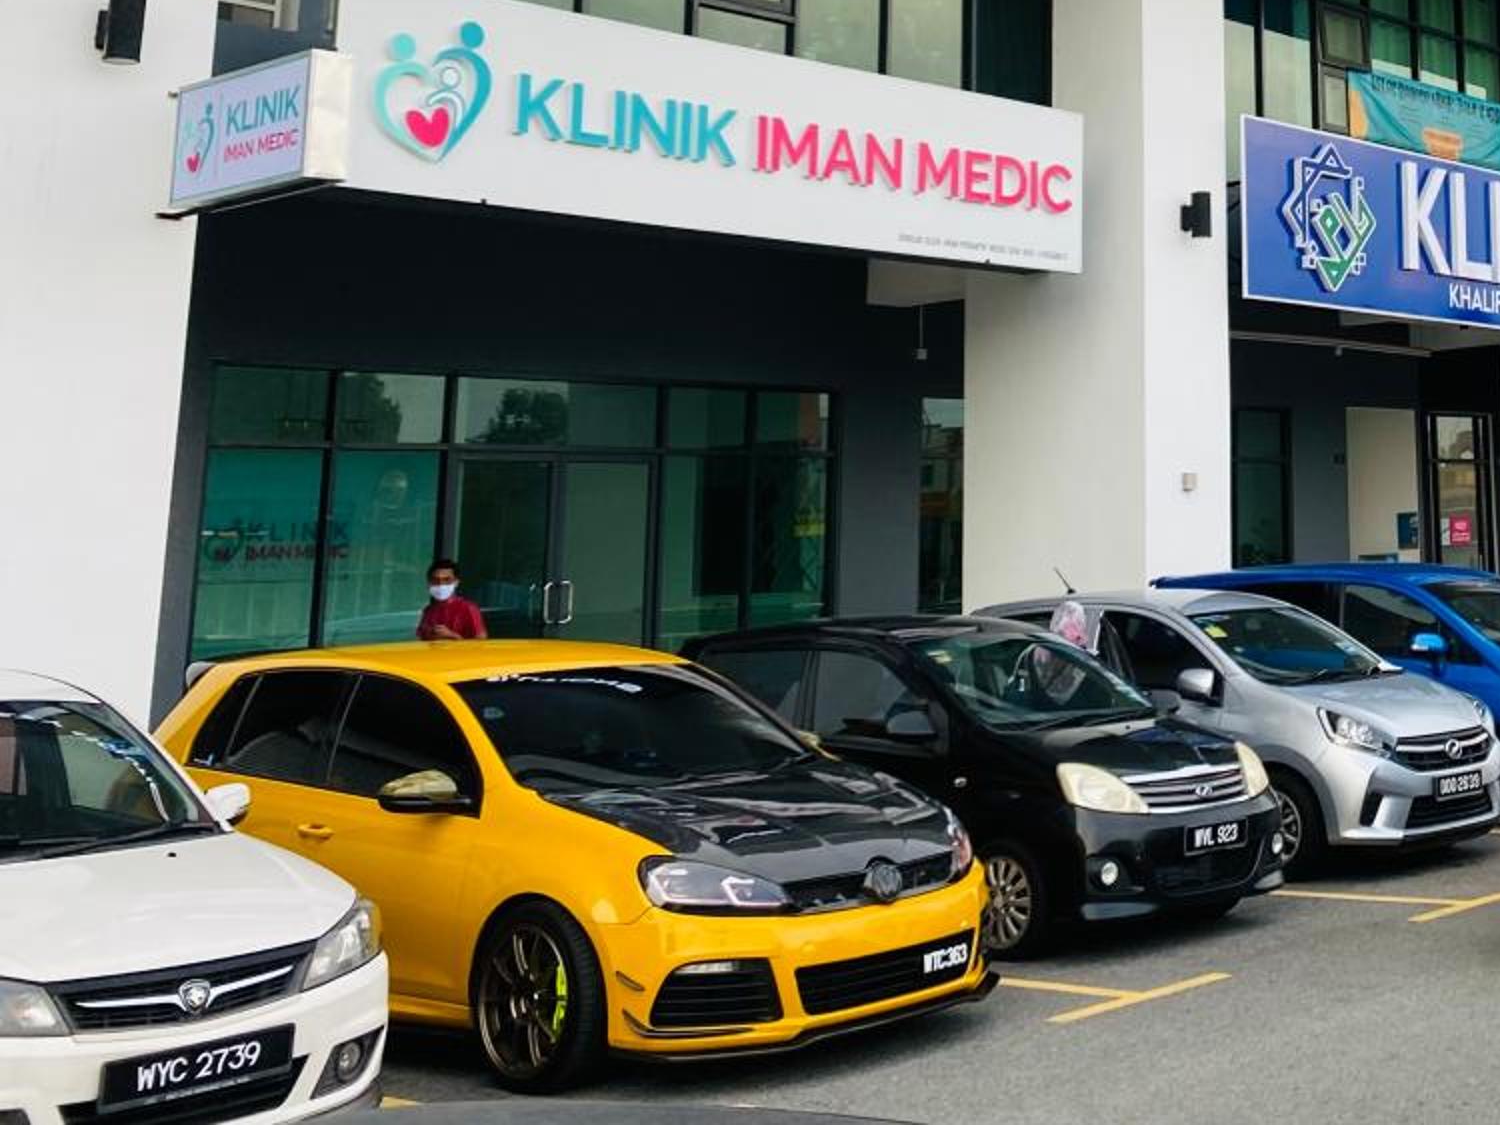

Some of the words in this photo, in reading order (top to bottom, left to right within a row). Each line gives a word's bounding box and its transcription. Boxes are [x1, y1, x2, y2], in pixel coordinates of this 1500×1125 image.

[225, 85, 300, 137] KLINIK
[223, 140, 254, 163] IMAN
[257, 128, 299, 155] MEDIC
[514, 74, 737, 166] KLINIK
[753, 115, 904, 192] IMAN
[914, 141, 1074, 215] MEDIC
[137, 1056, 188, 1092] WYC
[194, 1040, 262, 1079] 2739
